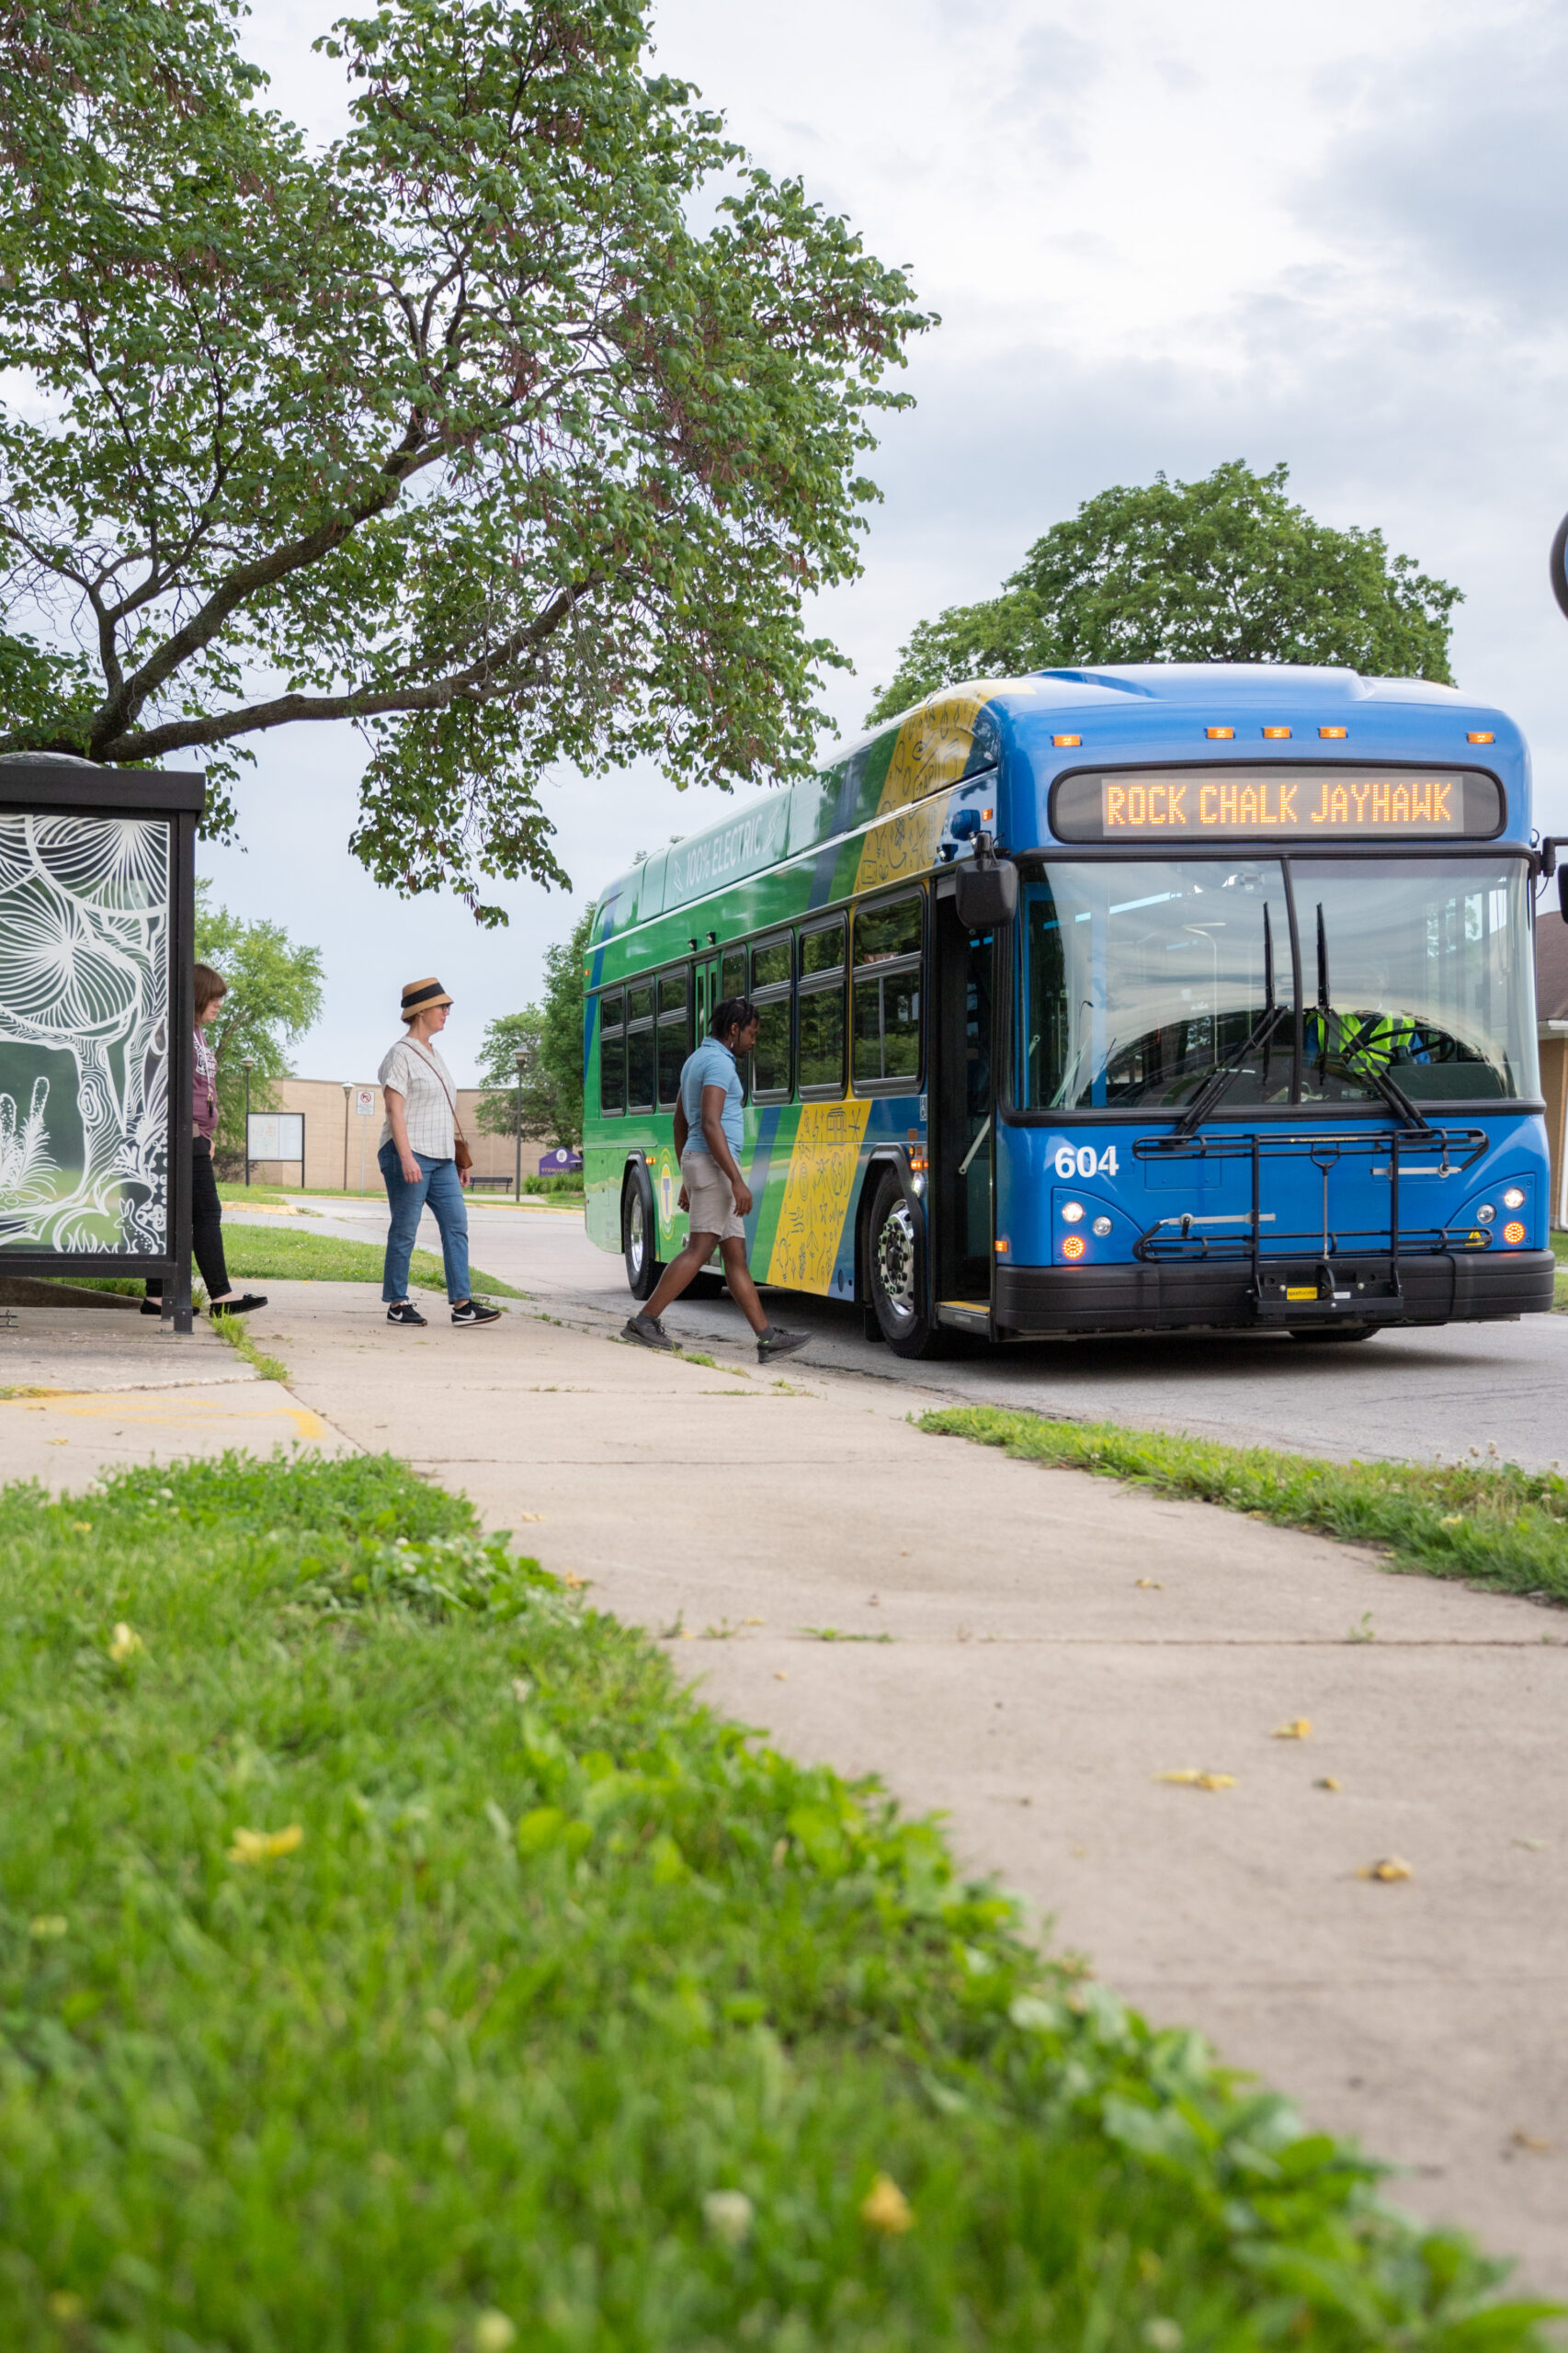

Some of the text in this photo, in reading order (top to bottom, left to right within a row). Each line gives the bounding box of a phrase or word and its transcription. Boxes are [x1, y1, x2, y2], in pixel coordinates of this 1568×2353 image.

[1107, 782, 1453, 825] ROCK CHALK JAYHAWK
[686, 813, 763, 888] 100% ELECTRIC
[1054, 1145, 1120, 1179] 604
